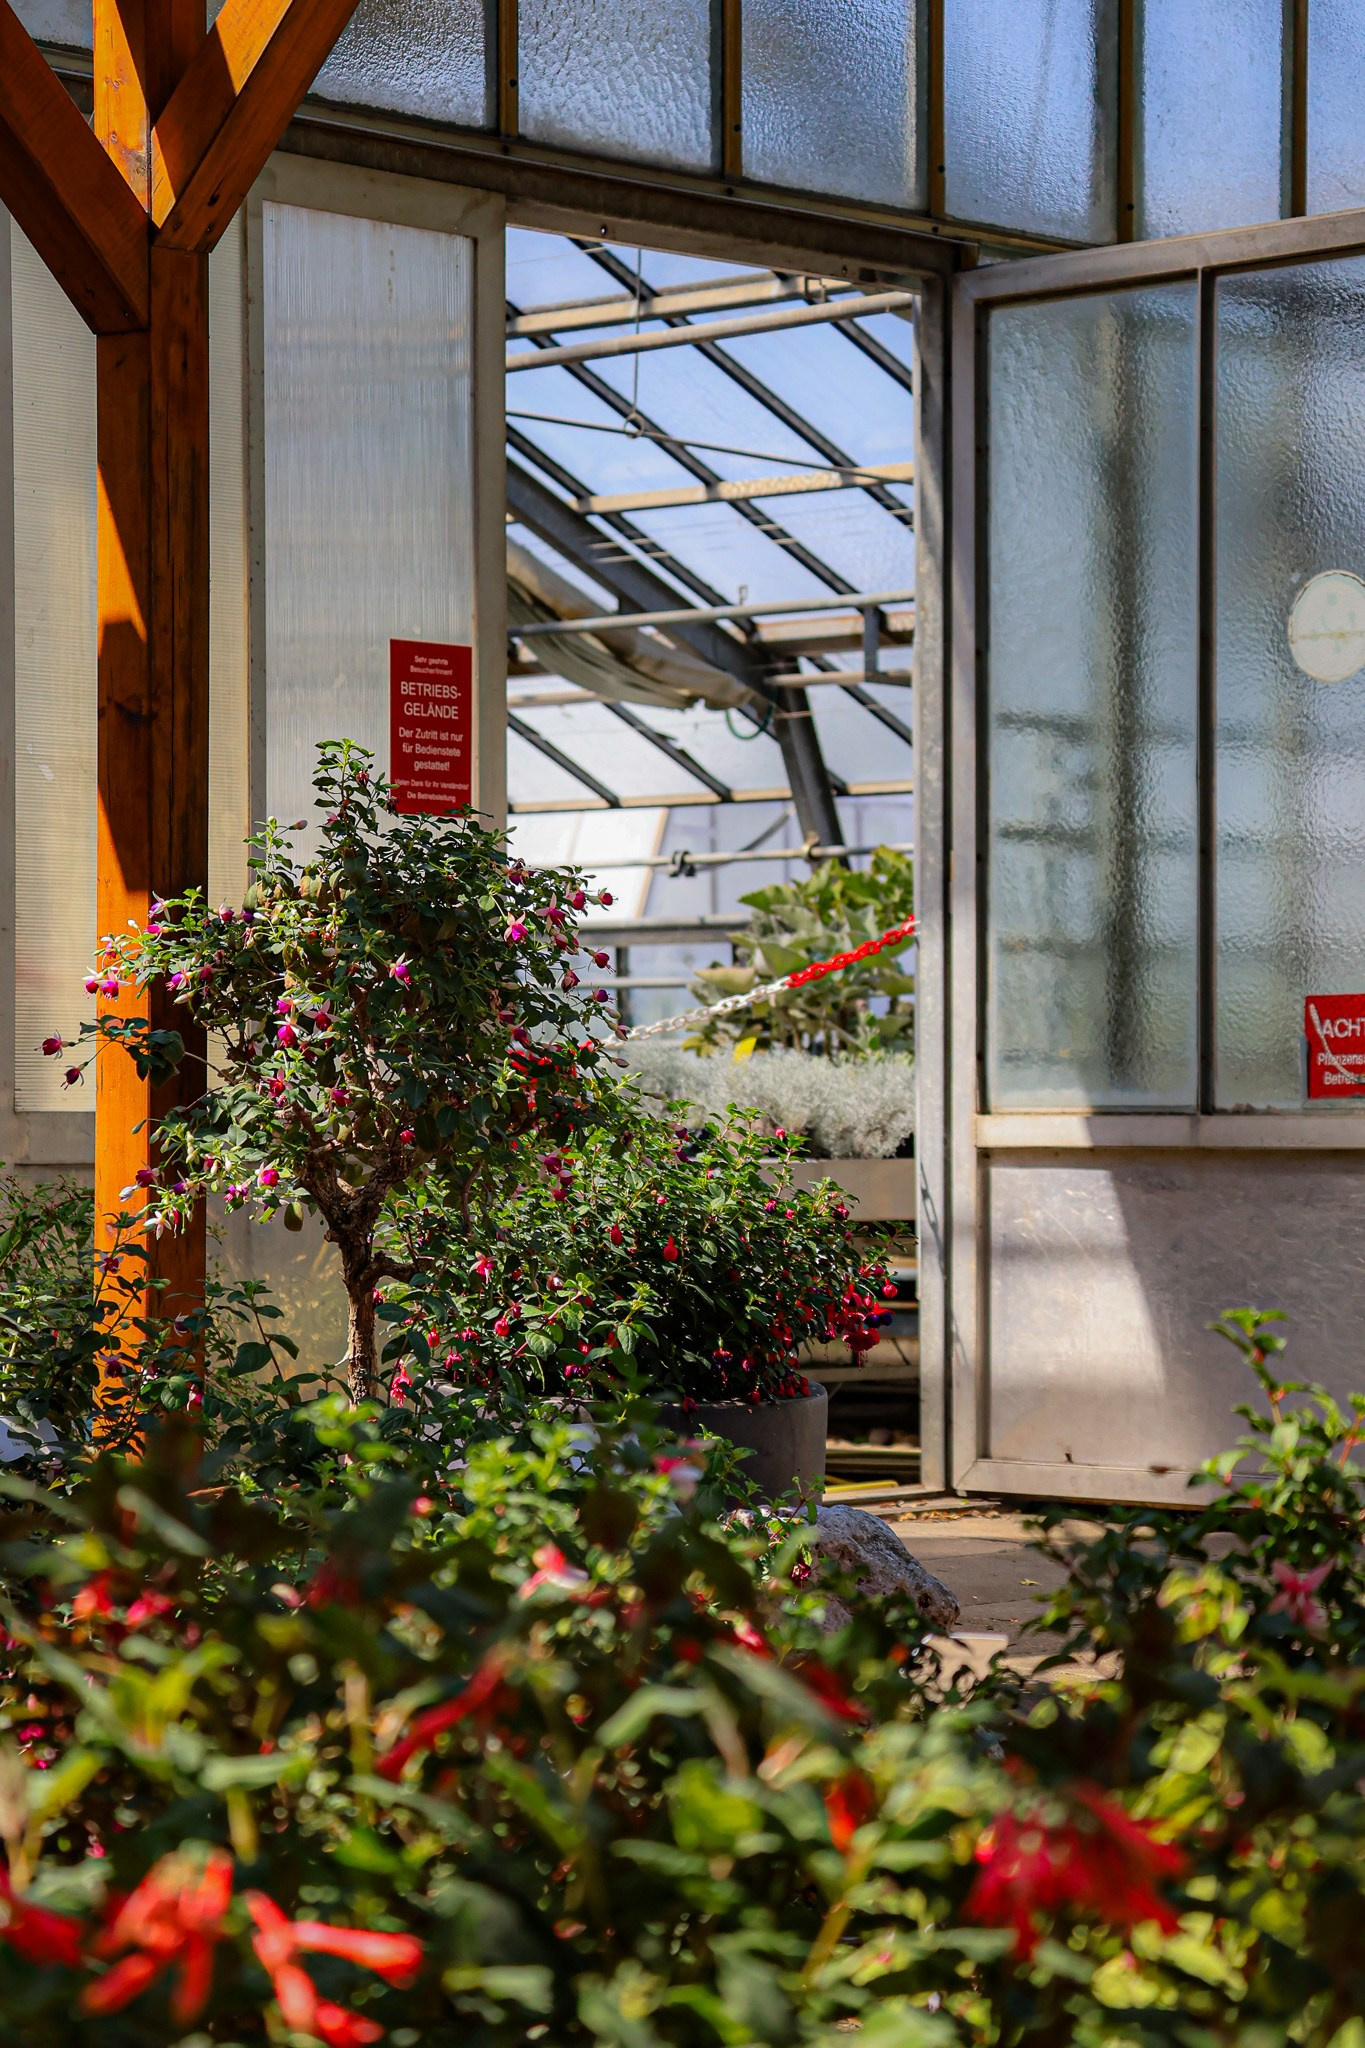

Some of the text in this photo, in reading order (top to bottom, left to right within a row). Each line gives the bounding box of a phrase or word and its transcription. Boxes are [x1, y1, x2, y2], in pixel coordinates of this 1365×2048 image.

[400, 681, 462, 699] BETRIEBS-
[403, 702, 459, 720] GELÄNDE
[398, 726, 463, 742] Der Zutritt ist nur
[402, 742, 461, 757] für Bedienstete
[413, 761, 450, 771] gestattet!
